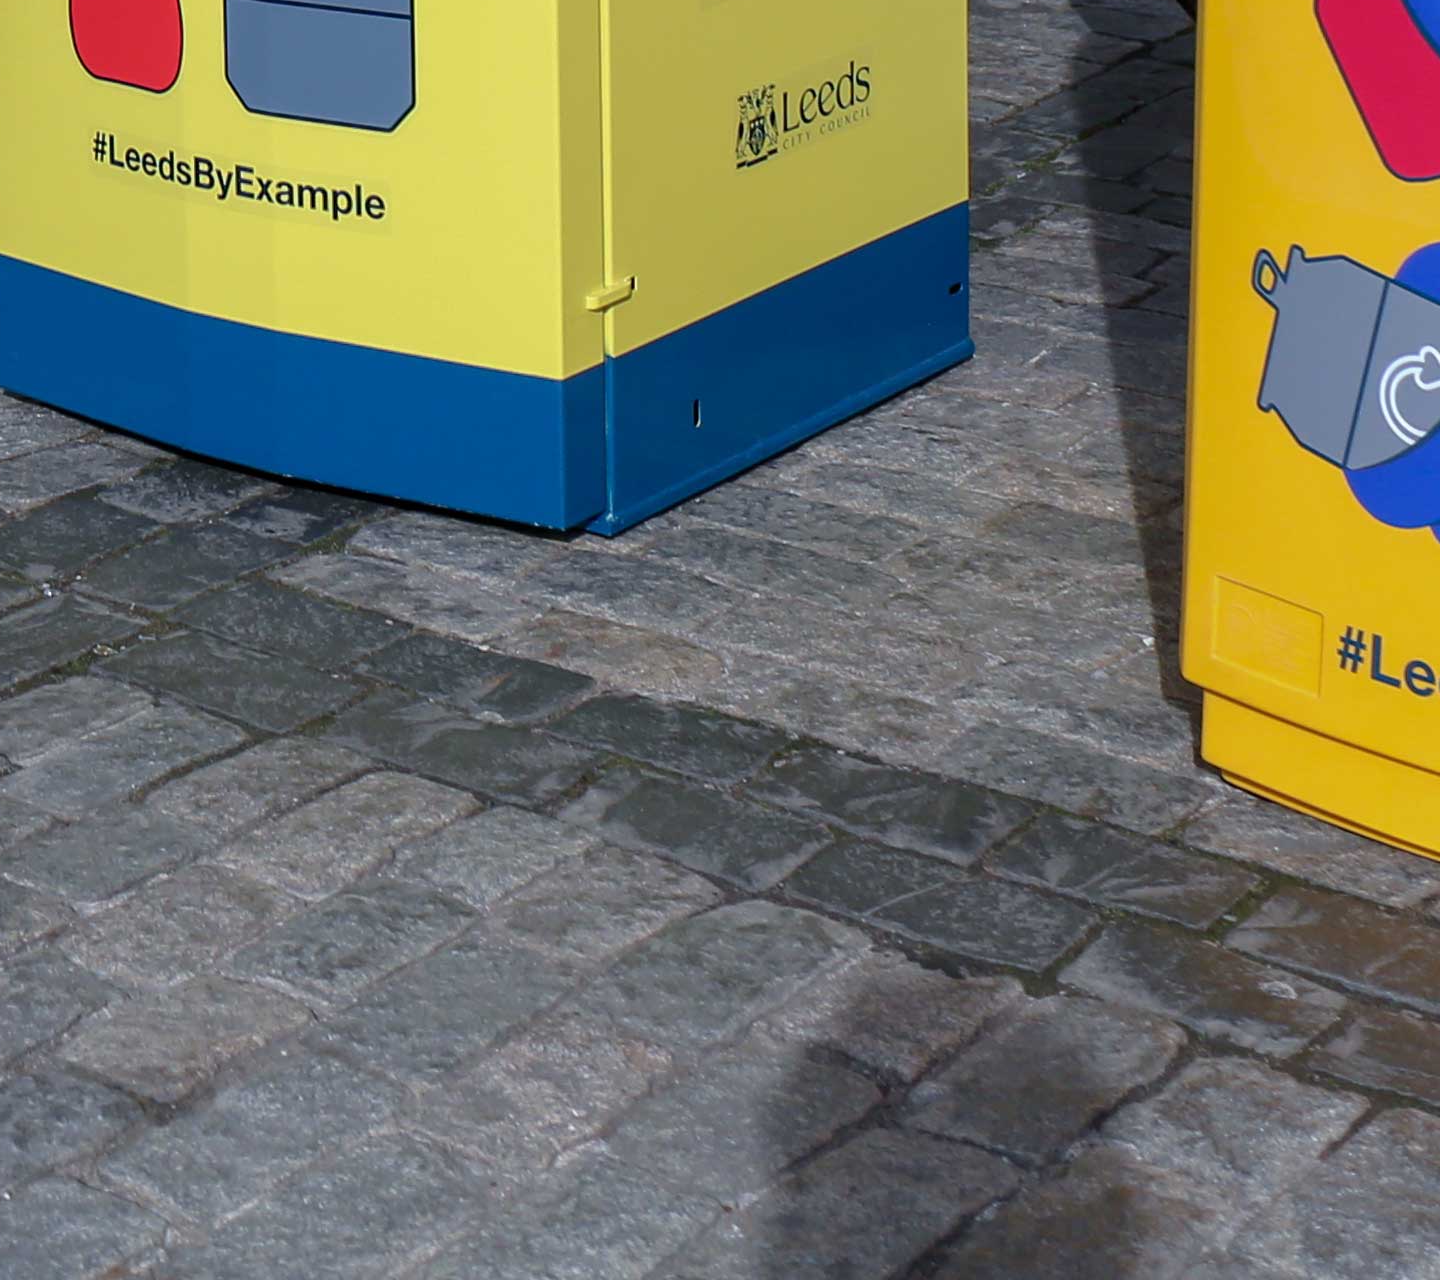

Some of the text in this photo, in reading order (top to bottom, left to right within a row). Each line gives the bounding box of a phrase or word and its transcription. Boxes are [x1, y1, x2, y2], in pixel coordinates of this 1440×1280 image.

[783, 60, 870, 133] Leeds
[783, 106, 870, 150] CITY COUNCIL
[92, 131, 386, 221] #LeedsByExample
